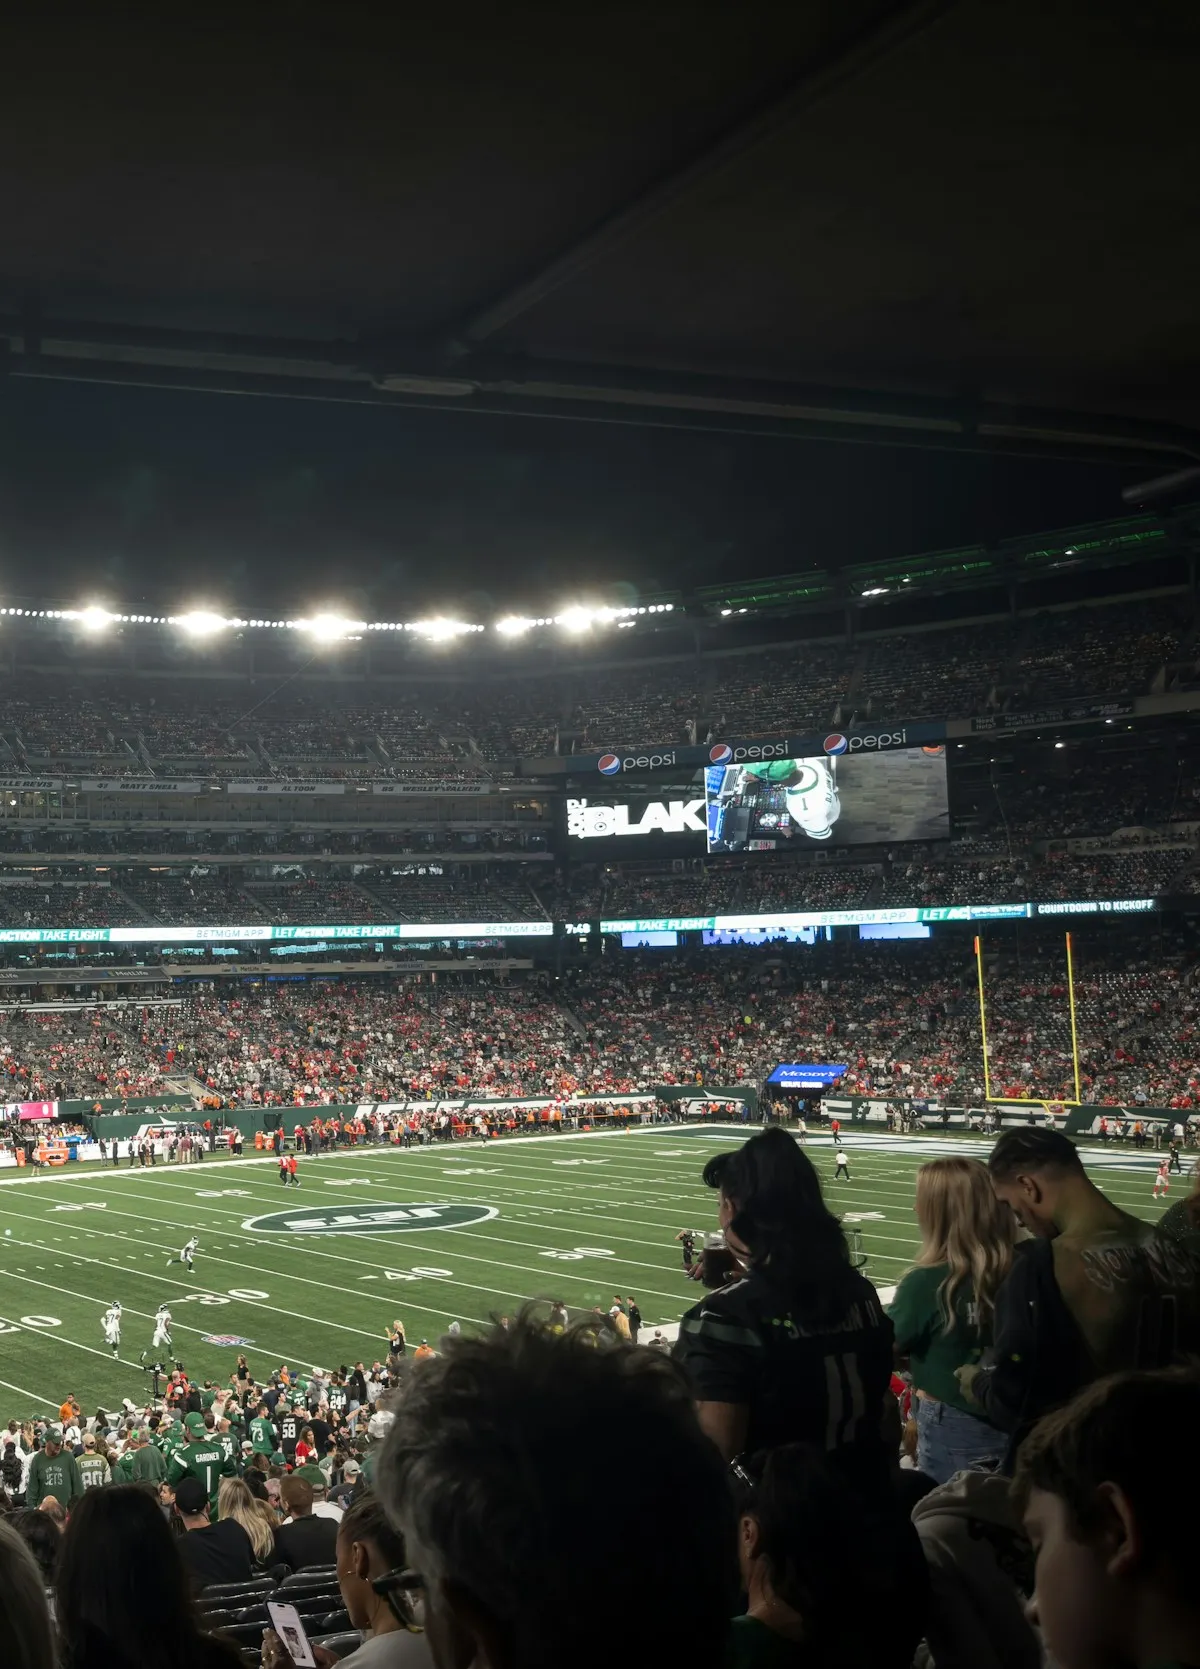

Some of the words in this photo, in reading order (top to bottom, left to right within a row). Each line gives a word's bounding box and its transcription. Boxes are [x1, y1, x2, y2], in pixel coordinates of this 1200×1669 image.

[849, 729, 907, 752] pepsi
[734, 740, 789, 762] pepsi
[622, 751, 676, 772] pepsi
[22, 780, 54, 788] REVIS
[119, 782, 147, 790] MATT
[1037, 902, 1097, 914] COUNTDOWN
[1098, 901, 1111, 911] TO
[1113, 899, 1154, 911] KICKOFF
[922, 909, 947, 921] LET
[275, 927, 296, 938] LET
[335, 927, 361, 938] TAKE
[637, 920, 667, 931] TAKE
[41, 931, 69, 941] TAKE
[195, 929, 240, 938] BETMGM
[538, 1246, 616, 1260] 50
[185, 1288, 270, 1305] 30
[251, 1427, 263, 1442] 73
[282, 1423, 297, 1439] 58
[195, 1451, 219, 1463] GARDNER
[45, 1472, 63, 1486] JETS
[206, 1465, 212, 1493] 1
